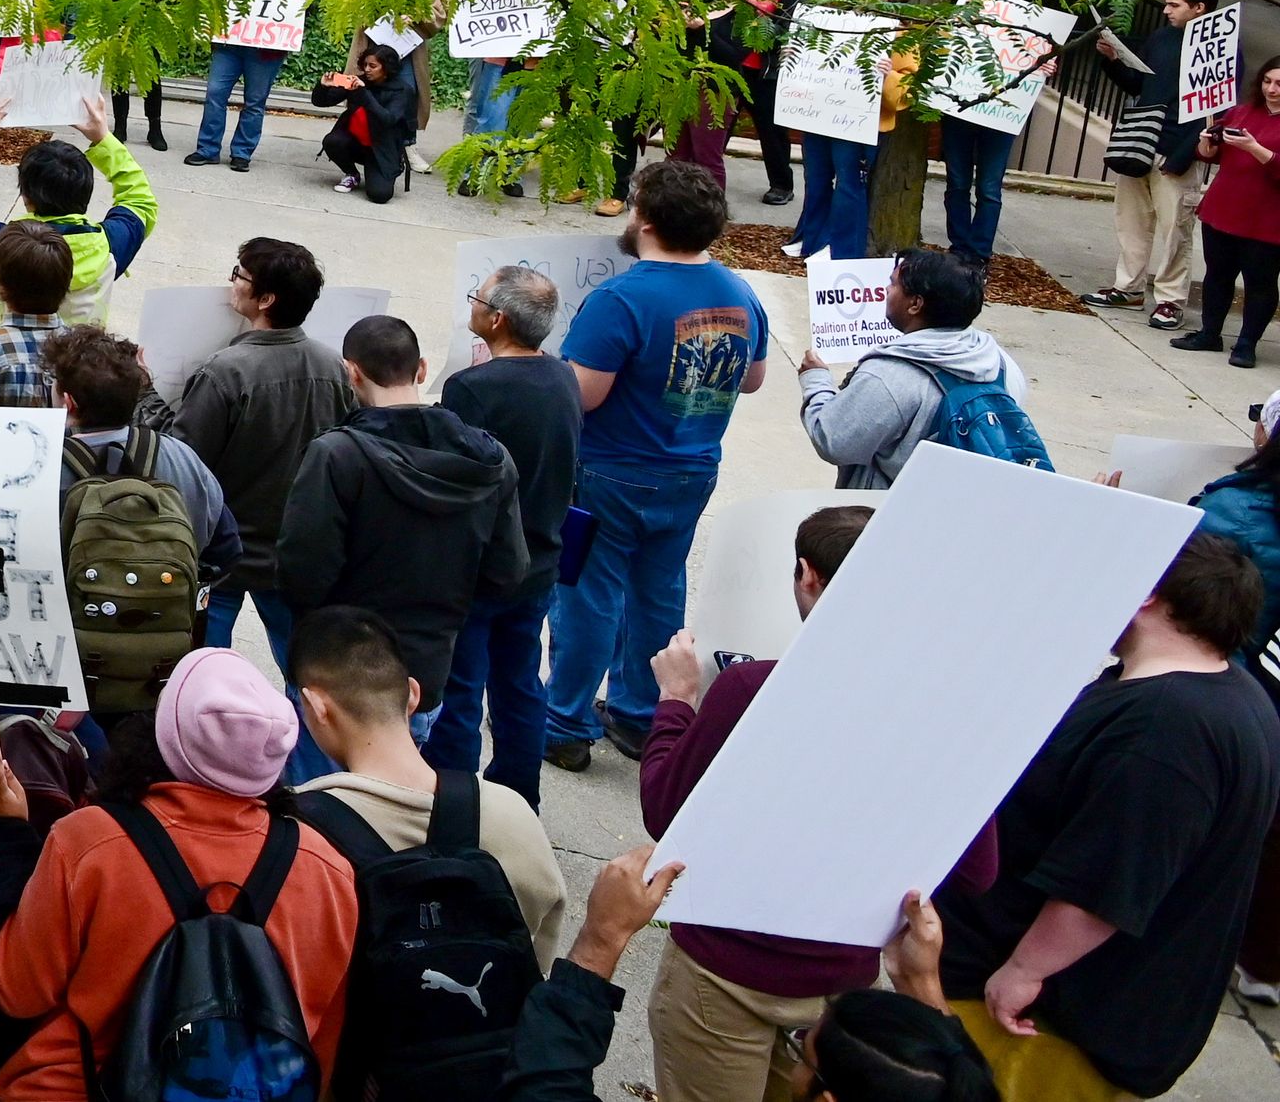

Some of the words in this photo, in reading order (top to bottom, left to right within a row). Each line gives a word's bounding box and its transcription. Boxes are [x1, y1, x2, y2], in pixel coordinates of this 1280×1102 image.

[257, 0, 285, 23] IS
[455, 13, 531, 44] LABOR!
[1189, 8, 1237, 46] FEES
[1191, 38, 1226, 67] ARE
[1188, 56, 1235, 90] WAGE
[1182, 77, 1235, 113] THEFT
[782, 103, 821, 119] wonder
[815, 287, 887, 305] WSU-CAS
[682, 320, 700, 331] THE
[812, 321, 847, 335] Coalition
[849, 320, 858, 331] of
[861, 319, 894, 331] Acad
[816, 336, 849, 349] Student
[852, 333, 901, 347] Employ
